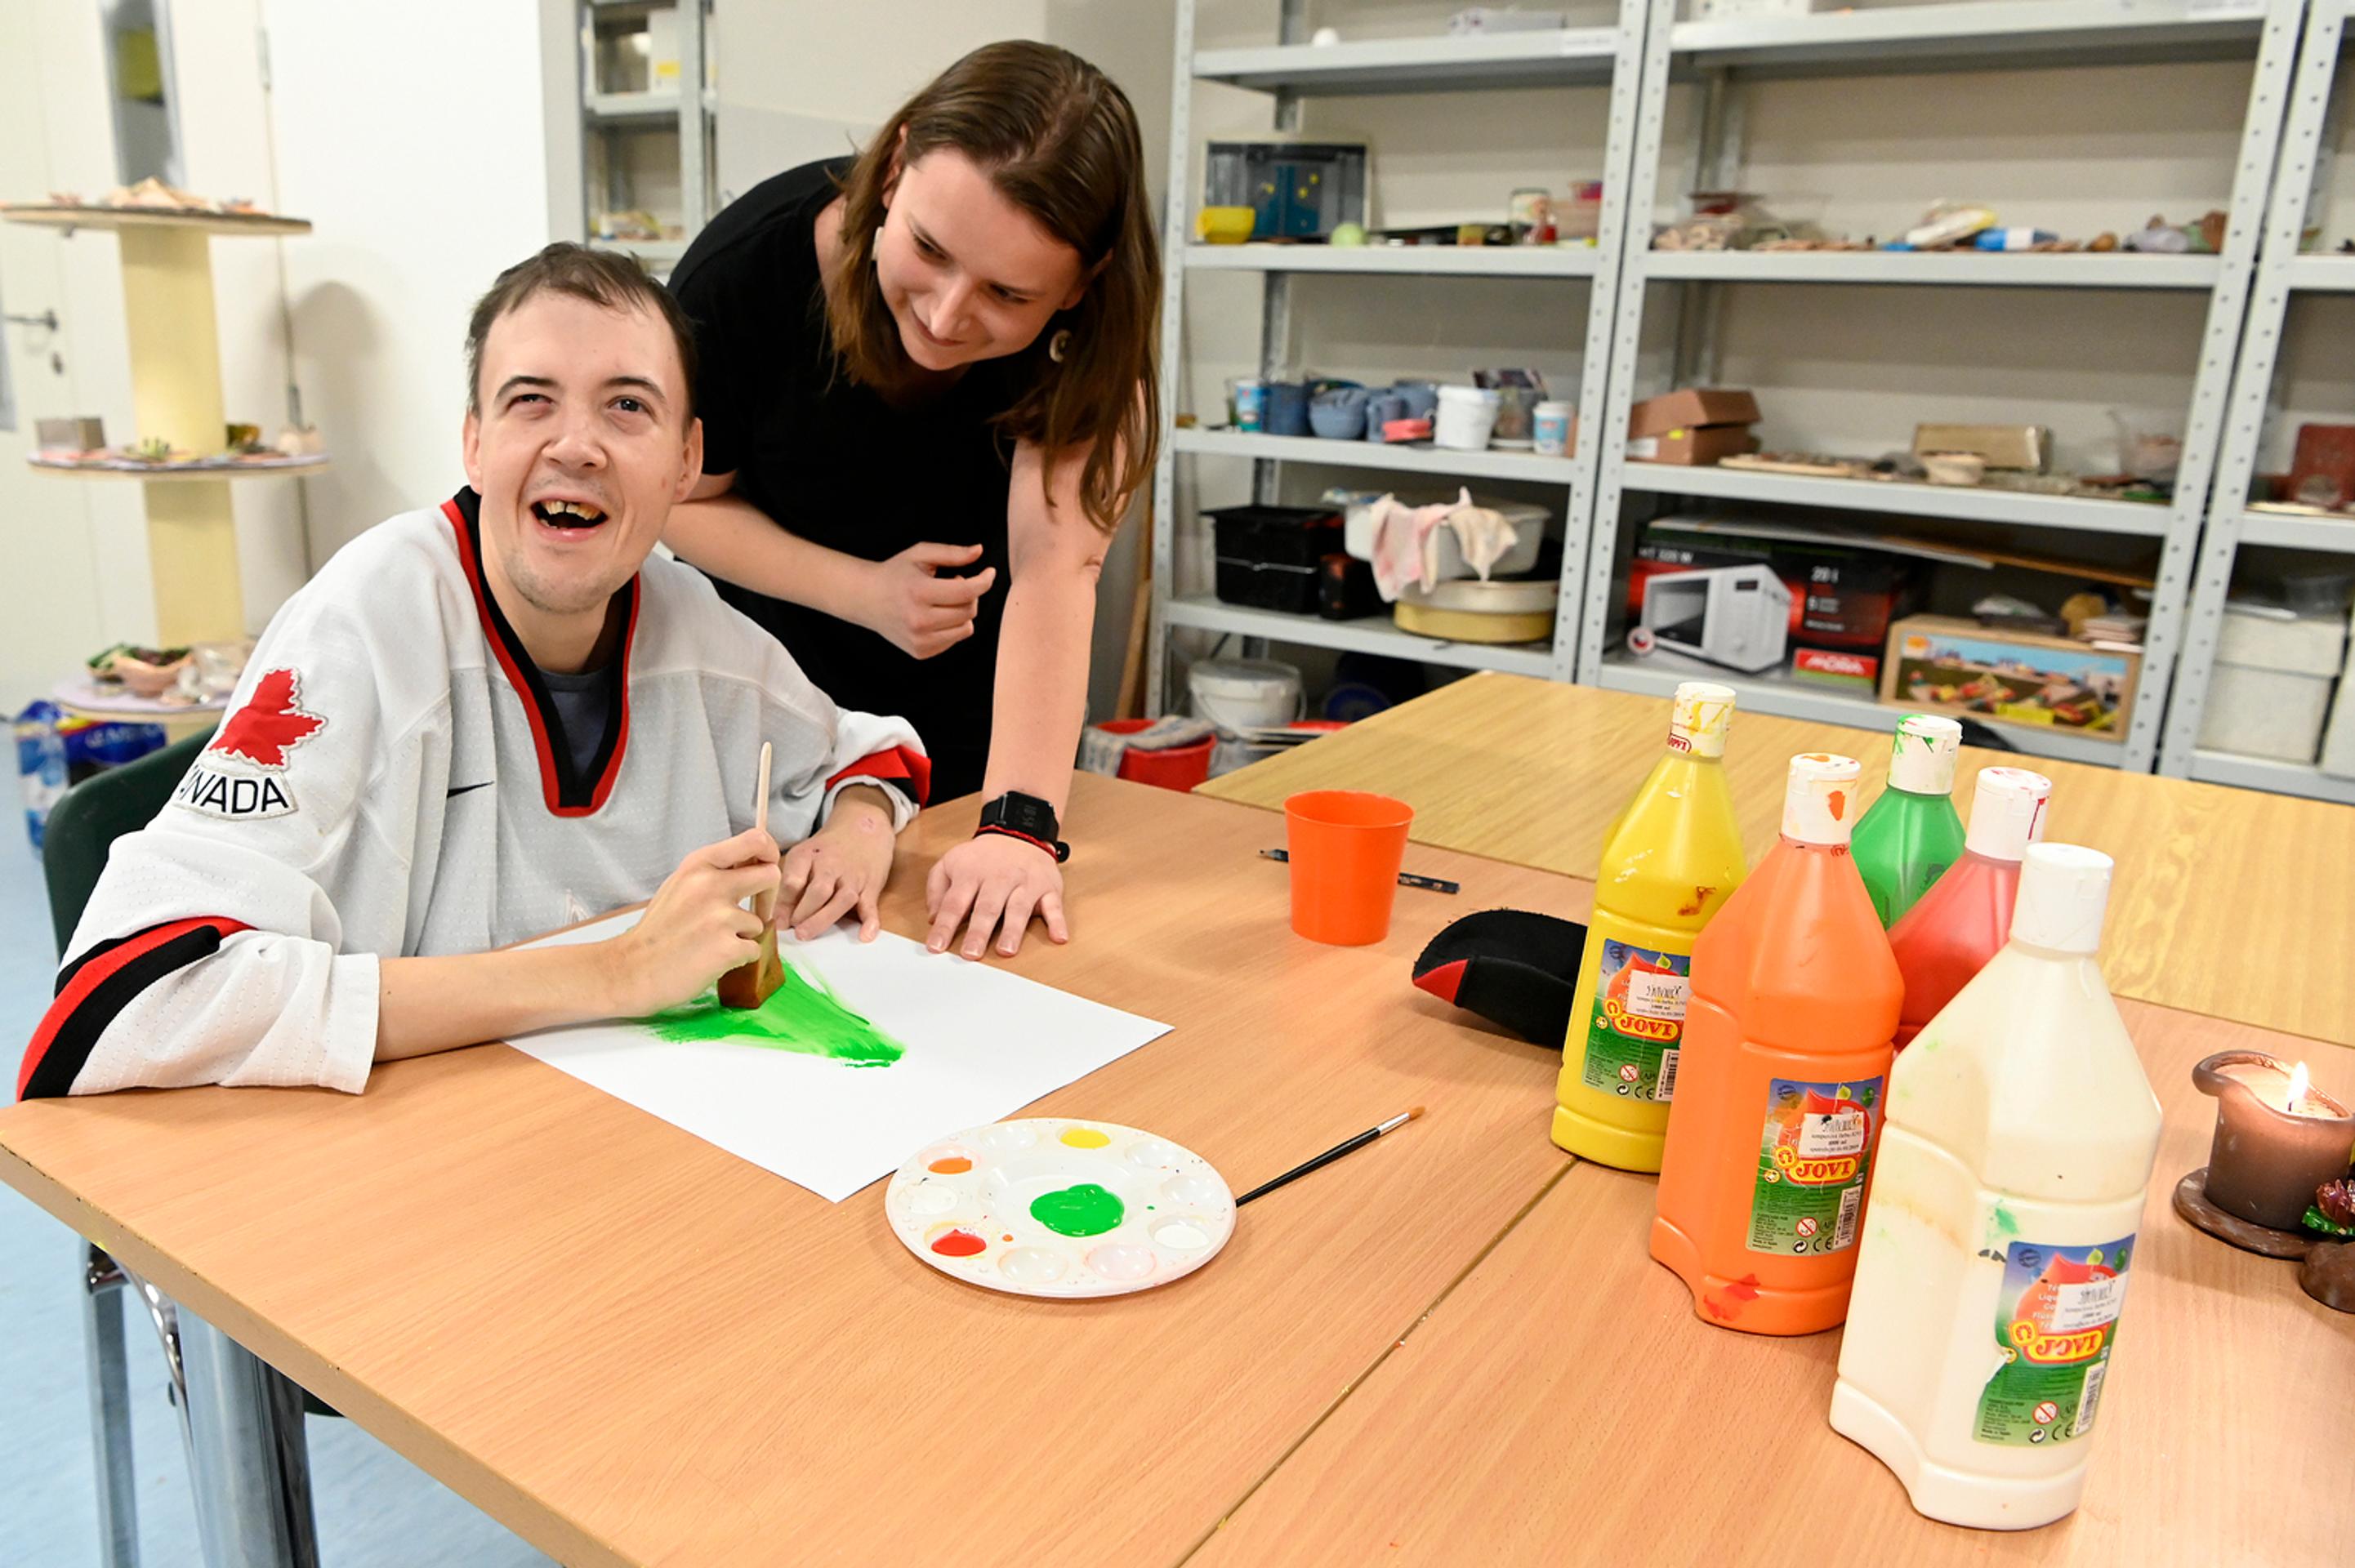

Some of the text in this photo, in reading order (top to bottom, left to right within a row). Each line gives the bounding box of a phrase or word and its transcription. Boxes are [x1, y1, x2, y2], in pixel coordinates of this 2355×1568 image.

[180, 764, 289, 813] NADA
[1620, 1016, 1674, 1036] JOVI
[1796, 1160, 1851, 1178] JOVI
[2036, 1333, 2097, 1356] JOVI
